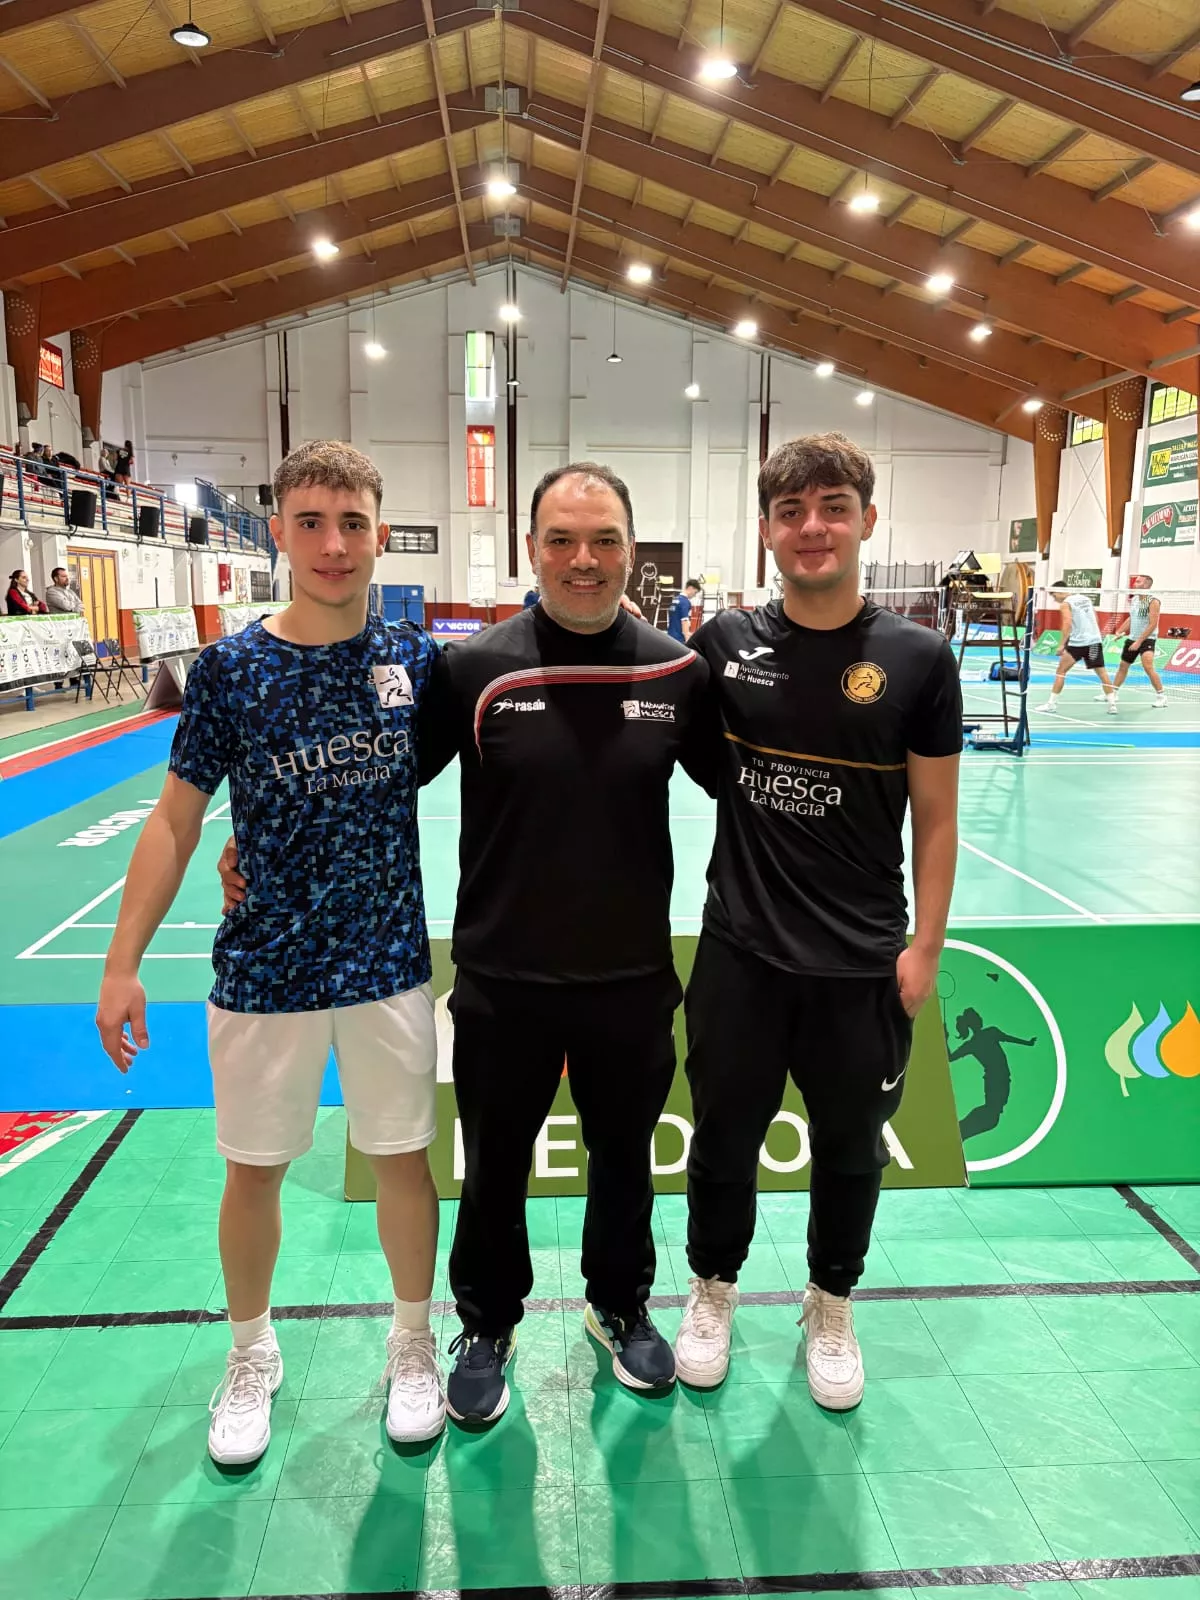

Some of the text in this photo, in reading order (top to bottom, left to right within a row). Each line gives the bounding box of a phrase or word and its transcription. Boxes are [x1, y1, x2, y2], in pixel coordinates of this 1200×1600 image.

[446, 622, 480, 631] VICTOR
[740, 664, 790, 680] Ayuntamiento
[747, 674, 775, 687] Huesca
[270, 729, 411, 780] Huesca
[305, 776, 327, 795] La
[737, 766, 842, 806] Huesca
[750, 790, 768, 806] La
